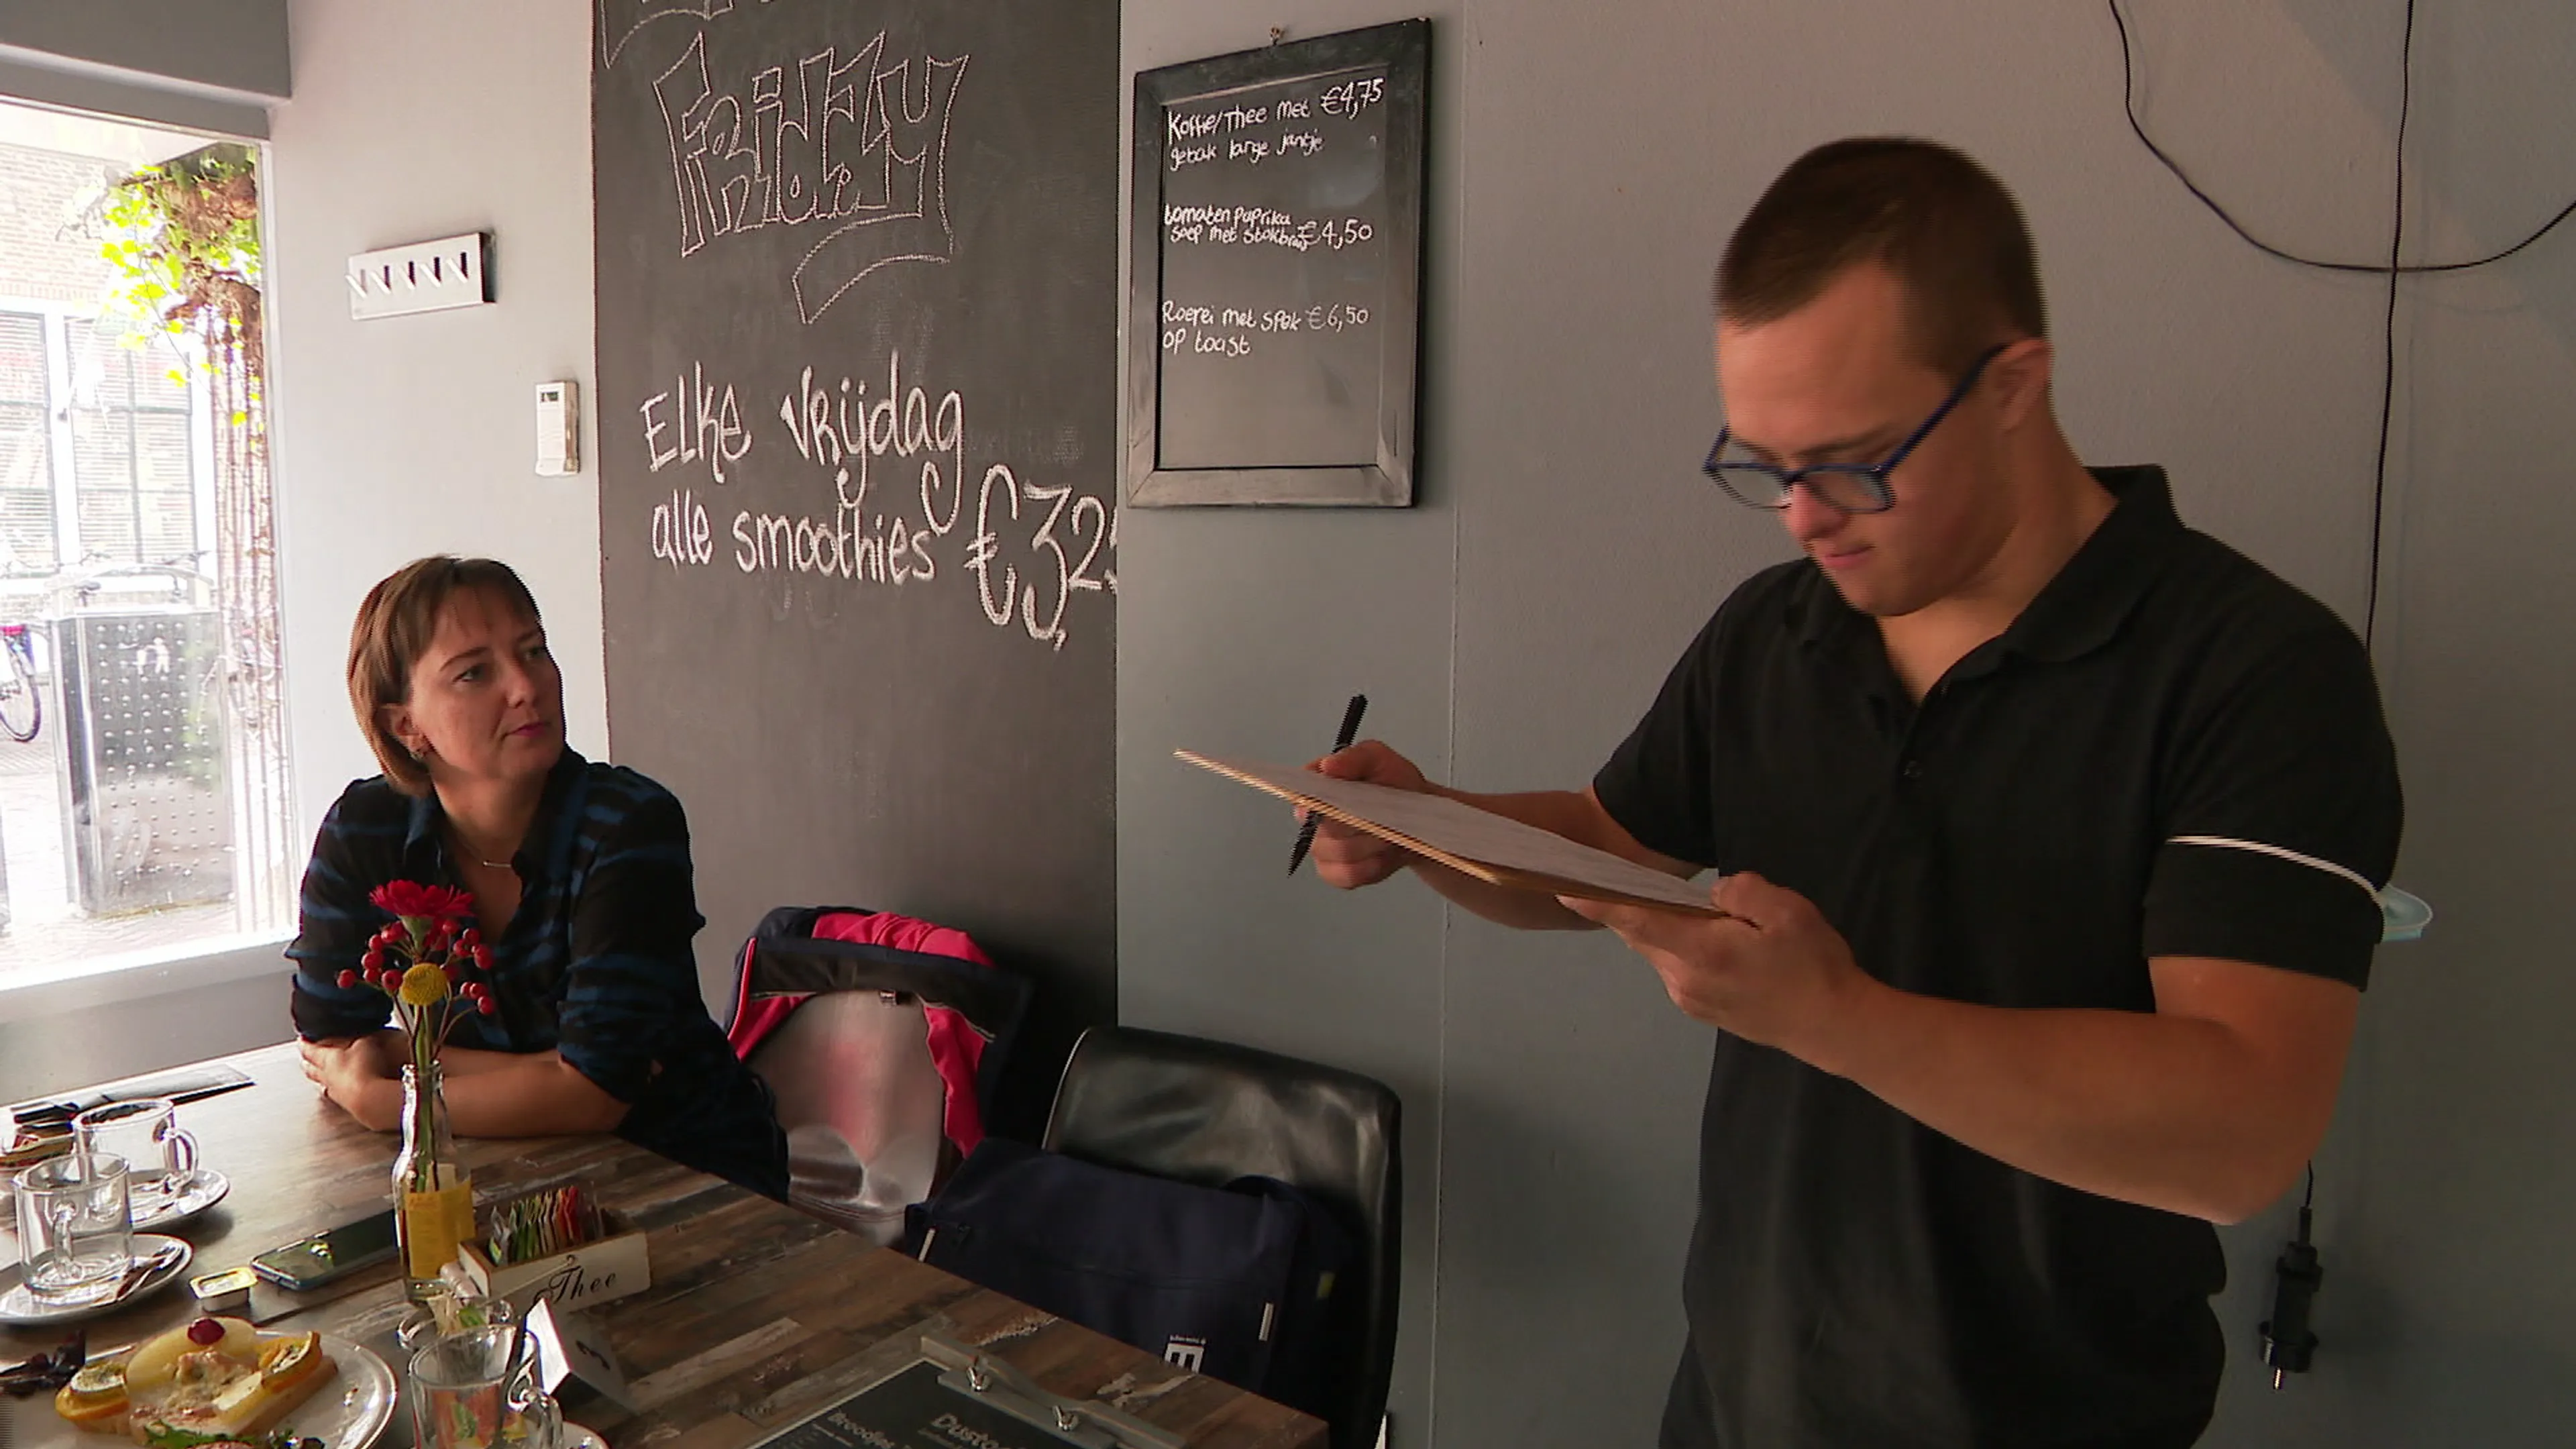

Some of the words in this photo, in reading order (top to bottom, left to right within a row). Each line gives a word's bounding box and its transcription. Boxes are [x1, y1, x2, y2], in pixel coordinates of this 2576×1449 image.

[1320, 78, 1385, 119] €4,75
[1170, 143, 1218, 172] gebak
[1165, 204, 1230, 225] tomaten
[1297, 219, 1373, 250] €4,50
[1162, 300, 1215, 327] Roerei
[1305, 303, 1369, 333] €6,50
[1194, 331, 1251, 357] toast
[641, 361, 753, 484] Elke
[652, 488, 712, 575] alle
[733, 504, 937, 586] smoothies
[535, 1254, 616, 1305] Thee
